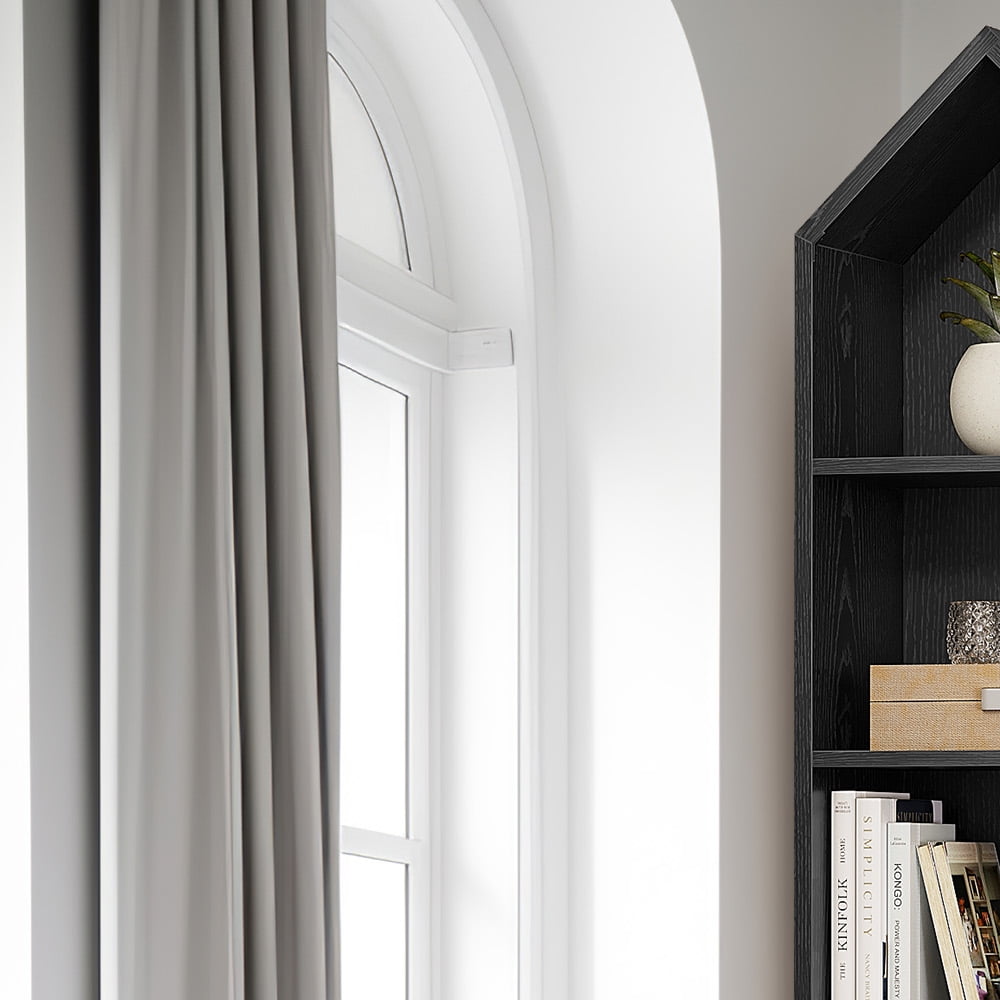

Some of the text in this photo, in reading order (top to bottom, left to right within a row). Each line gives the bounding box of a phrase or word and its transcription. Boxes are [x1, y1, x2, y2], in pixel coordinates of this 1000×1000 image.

[863, 816, 872, 936] SIMPLICITY
[893, 863, 902, 910] KONGO:
[837, 879, 848, 952] KINFOLK
